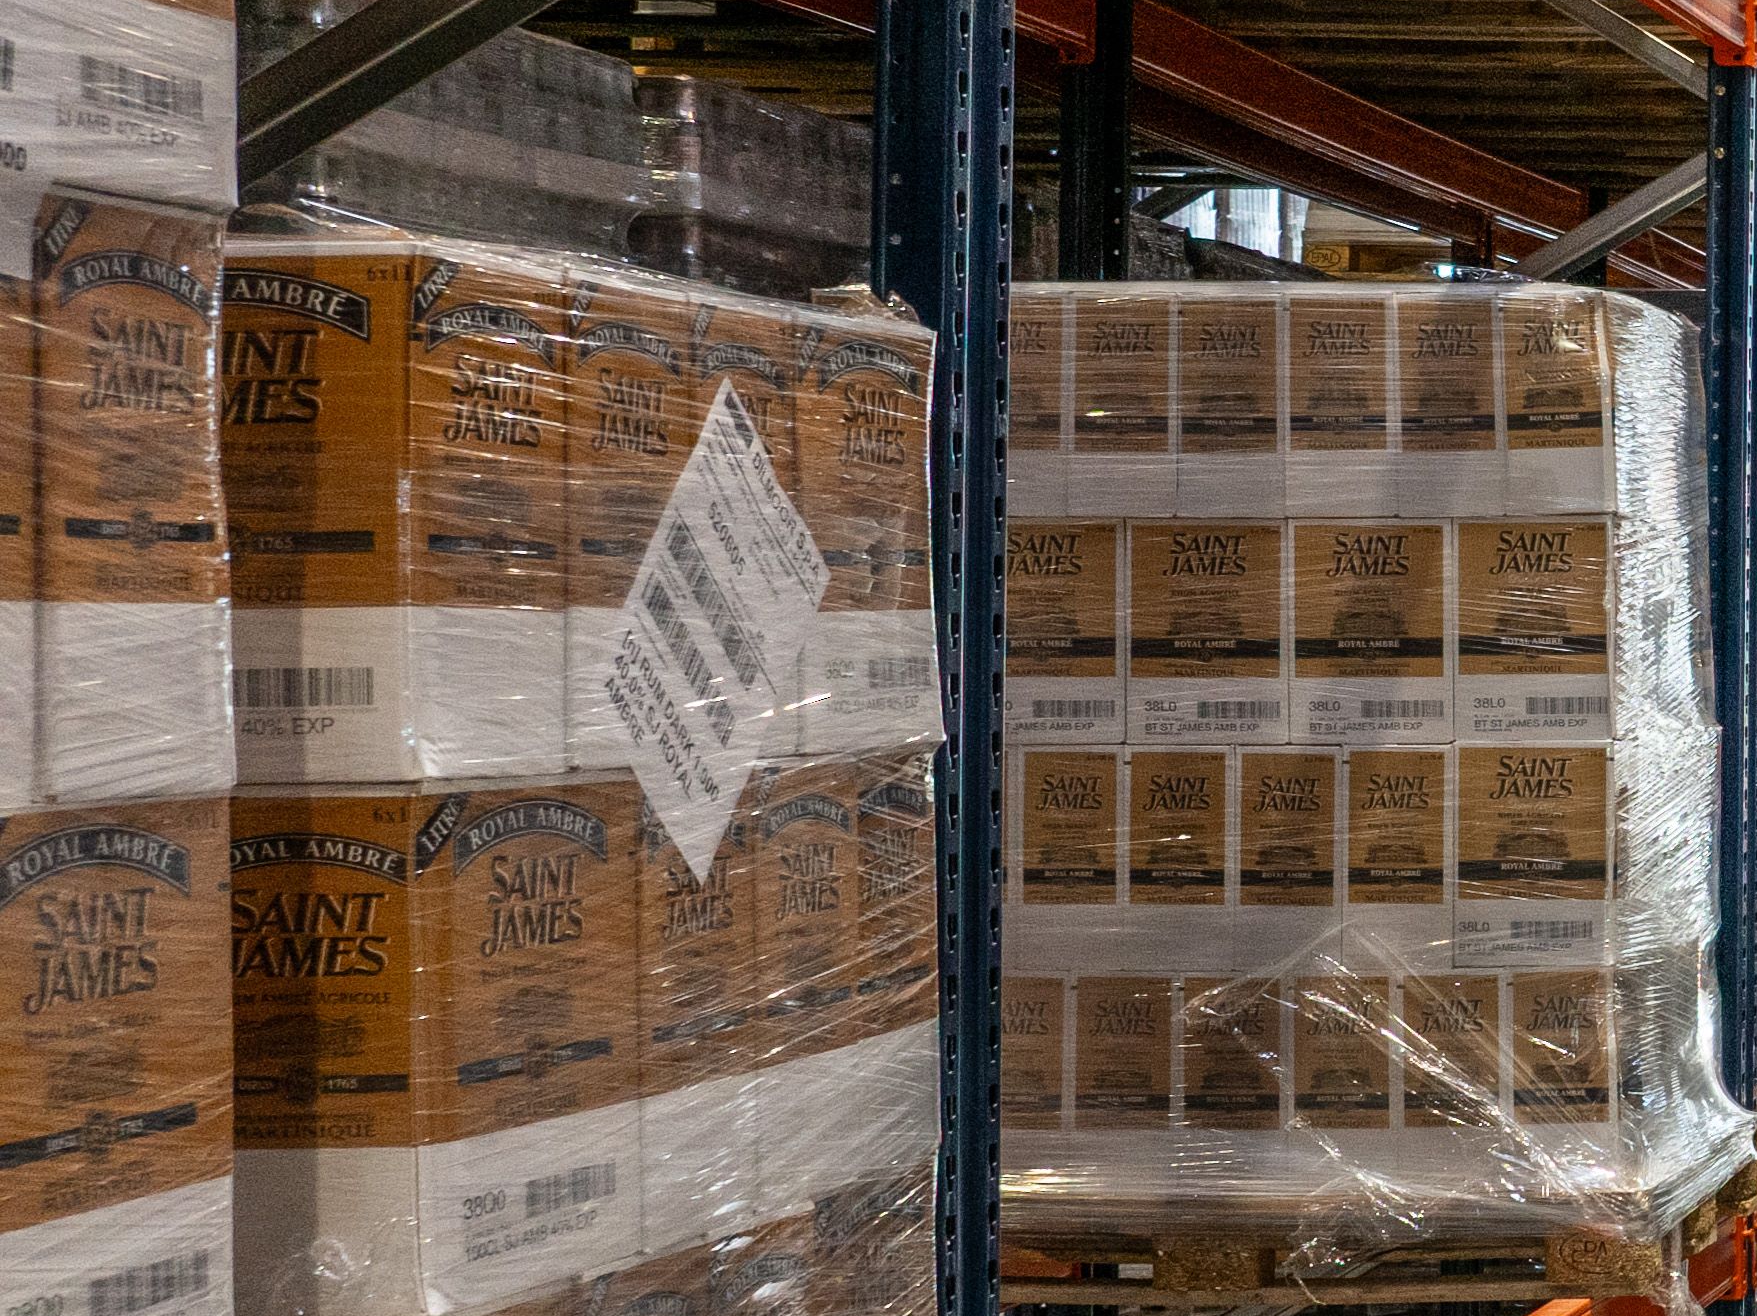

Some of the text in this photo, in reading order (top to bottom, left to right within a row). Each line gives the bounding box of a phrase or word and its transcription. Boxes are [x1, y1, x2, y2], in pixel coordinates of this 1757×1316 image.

[72, 254, 130, 286] ROYAL
[441, 311, 491, 335] ROYAL
[1310, 321, 1370, 338] SAINT
[1418, 321, 1478, 338] SAINT
[90, 308, 196, 368] SAINT
[1303, 338, 1370, 356] JAMES
[1412, 338, 1478, 357] JAMES
[80, 362, 197, 412] JAMES
[452, 356, 537, 407] SAINT
[443, 400, 542, 448] JAMES
[591, 409, 669, 456] JAMES
[1007, 534, 1082, 556] SAINT
[1169, 533, 1246, 555] SAINT
[1335, 533, 1408, 555] SAINT
[1496, 531, 1572, 552] SAINT
[1163, 556, 1246, 576] JAMES
[1325, 556, 1409, 576] JAMES
[1489, 552, 1573, 574] JAMES
[1174, 640, 1201, 648] ROYAL
[1338, 640, 1366, 648] ROYAL
[1144, 700, 1177, 712] 38L0
[1309, 701, 1341, 712] 38L0
[1474, 697, 1505, 709] 38L0
[292, 717, 335, 735] EXP
[1213, 723, 1236, 732] AMB
[1377, 721, 1423, 731] AMB EXP
[1474, 718, 1588, 729] BT ST AMB EXP
[658, 731, 693, 802] ROYAL
[1497, 756, 1573, 777] SAINT
[1041, 775, 1102, 792] SAINT
[1150, 775, 1210, 793] SAINT
[1259, 776, 1321, 794] SAINT
[1368, 774, 1429, 792] SAINT
[1489, 778, 1573, 799] JAMES
[1036, 793, 1102, 810] JAMES
[1143, 793, 1210, 811] JAMES
[1253, 794, 1321, 812] JAMES
[1362, 793, 1429, 810] JAMES
[470, 810, 527, 850] ROYAL
[8, 834, 82, 883] ROYAL
[1501, 863, 1529, 871] ROYAL
[490, 854, 581, 905] SAINT
[37, 888, 153, 946] SAINT
[231, 891, 390, 934] SAINT
[481, 897, 583, 958] JAMES
[1459, 921, 1490, 933] 38L0
[23, 941, 158, 1016] JAMES
[1532, 995, 1596, 1012] SAINT
